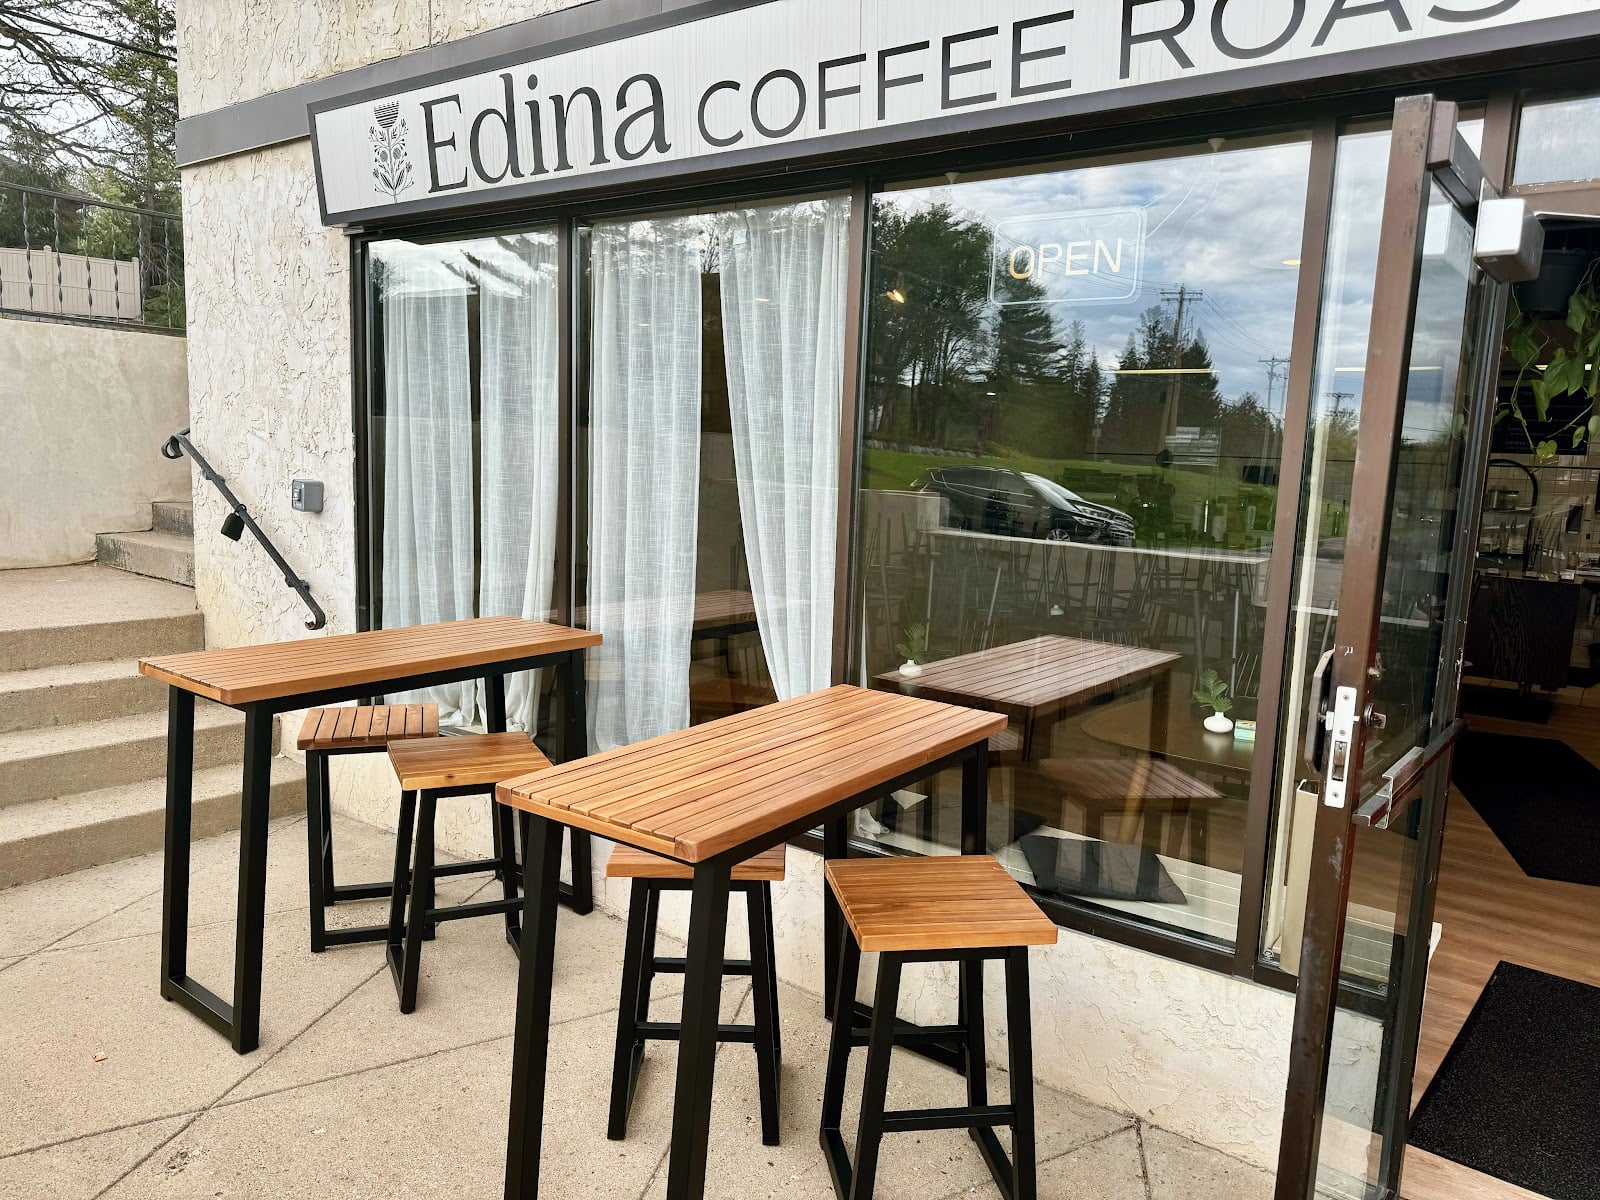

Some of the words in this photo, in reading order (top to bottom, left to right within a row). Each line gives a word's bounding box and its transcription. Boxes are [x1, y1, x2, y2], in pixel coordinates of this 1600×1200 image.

[419, 73, 671, 193] Edina
[698, 10, 1075, 147] COFFEE
[1119, 0, 1521, 80] ROA
[1009, 238, 1122, 280] OPEN
